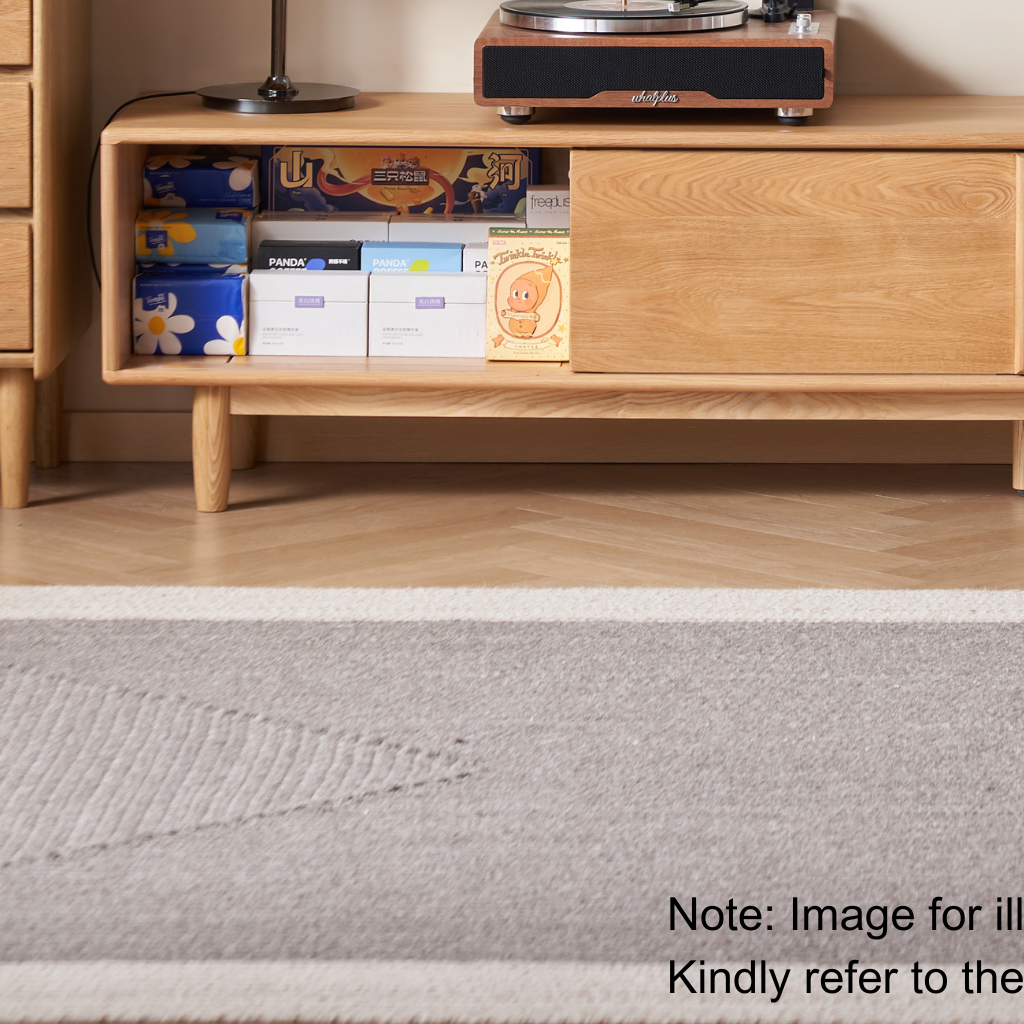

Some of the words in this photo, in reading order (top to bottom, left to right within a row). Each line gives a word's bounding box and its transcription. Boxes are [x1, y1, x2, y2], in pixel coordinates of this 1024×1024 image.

[280, 151, 314, 189] 山
[373, 170, 427, 183] 三只松鼠
[269, 257, 306, 267] PANDA
[373, 259, 407, 267] PANDA
